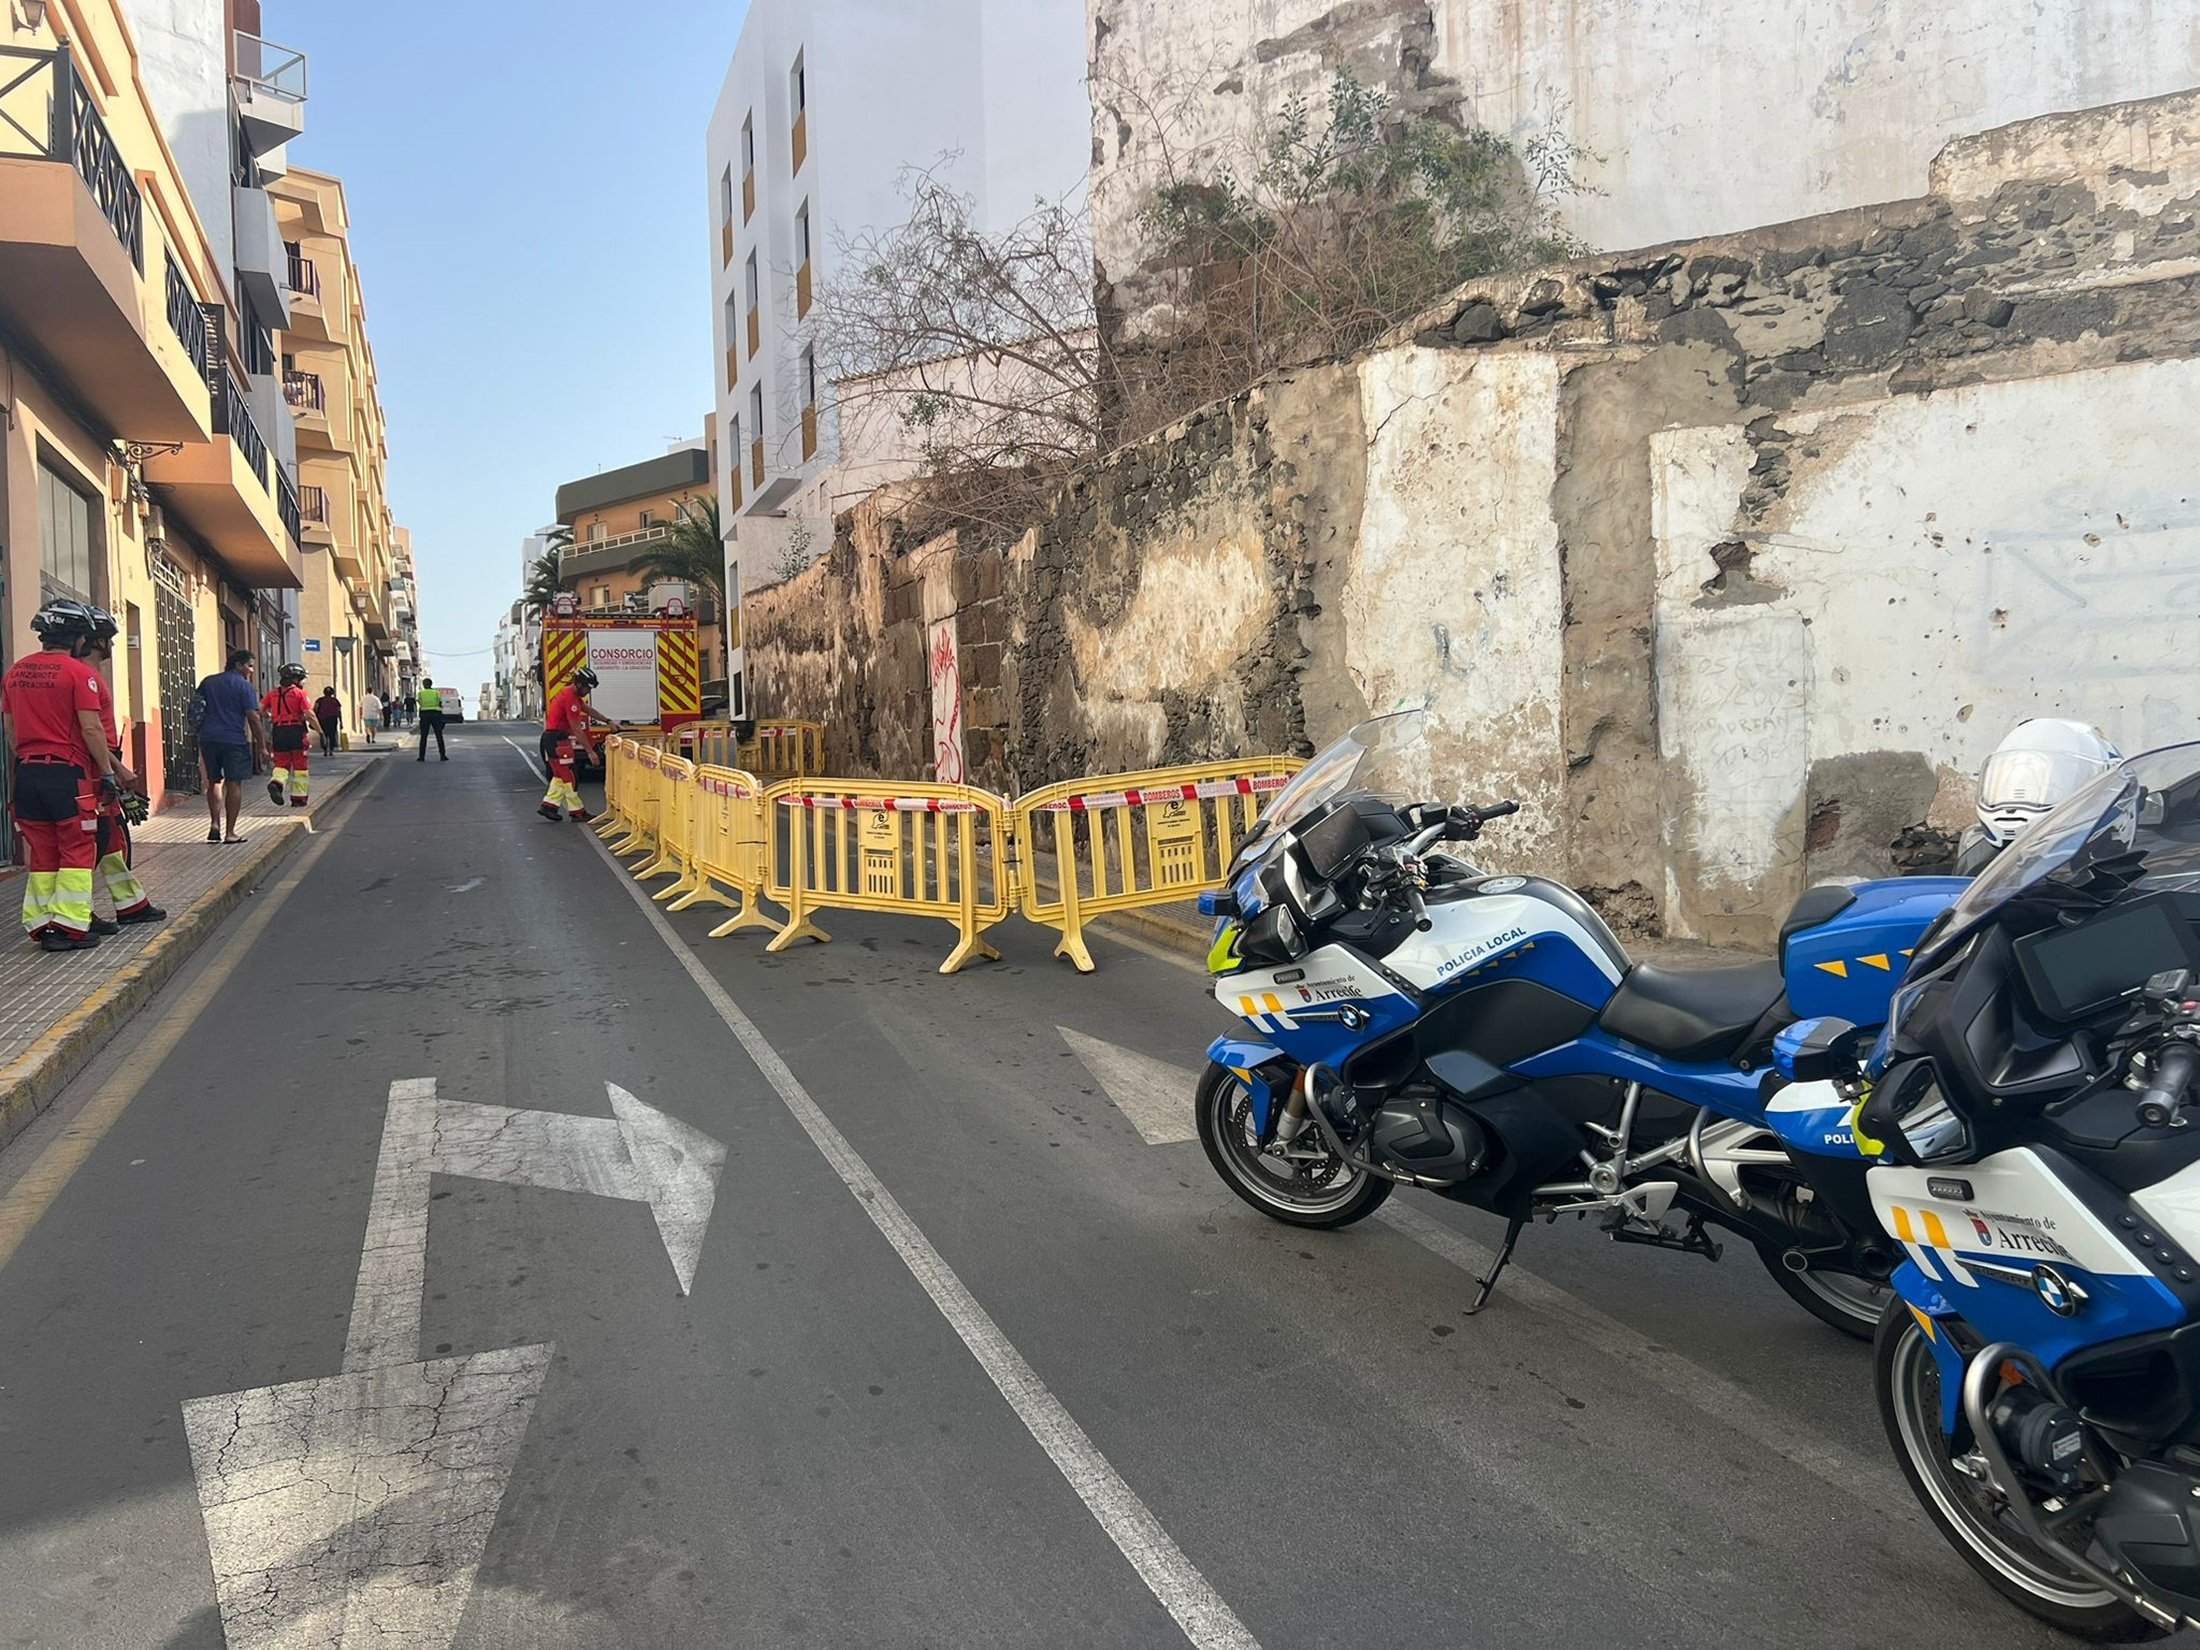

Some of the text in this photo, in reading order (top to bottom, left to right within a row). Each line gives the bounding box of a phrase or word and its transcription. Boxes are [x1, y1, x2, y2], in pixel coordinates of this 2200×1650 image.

[591, 648, 653, 659] CONSORCIO
[1143, 788, 1181, 802] BOMBEROS
[1436, 927, 1527, 977] POLICIA LOCAL
[1314, 985, 1363, 1002] Arrecife
[1823, 1133, 1855, 1145] POLI
[2043, 1216, 2057, 1230] de
